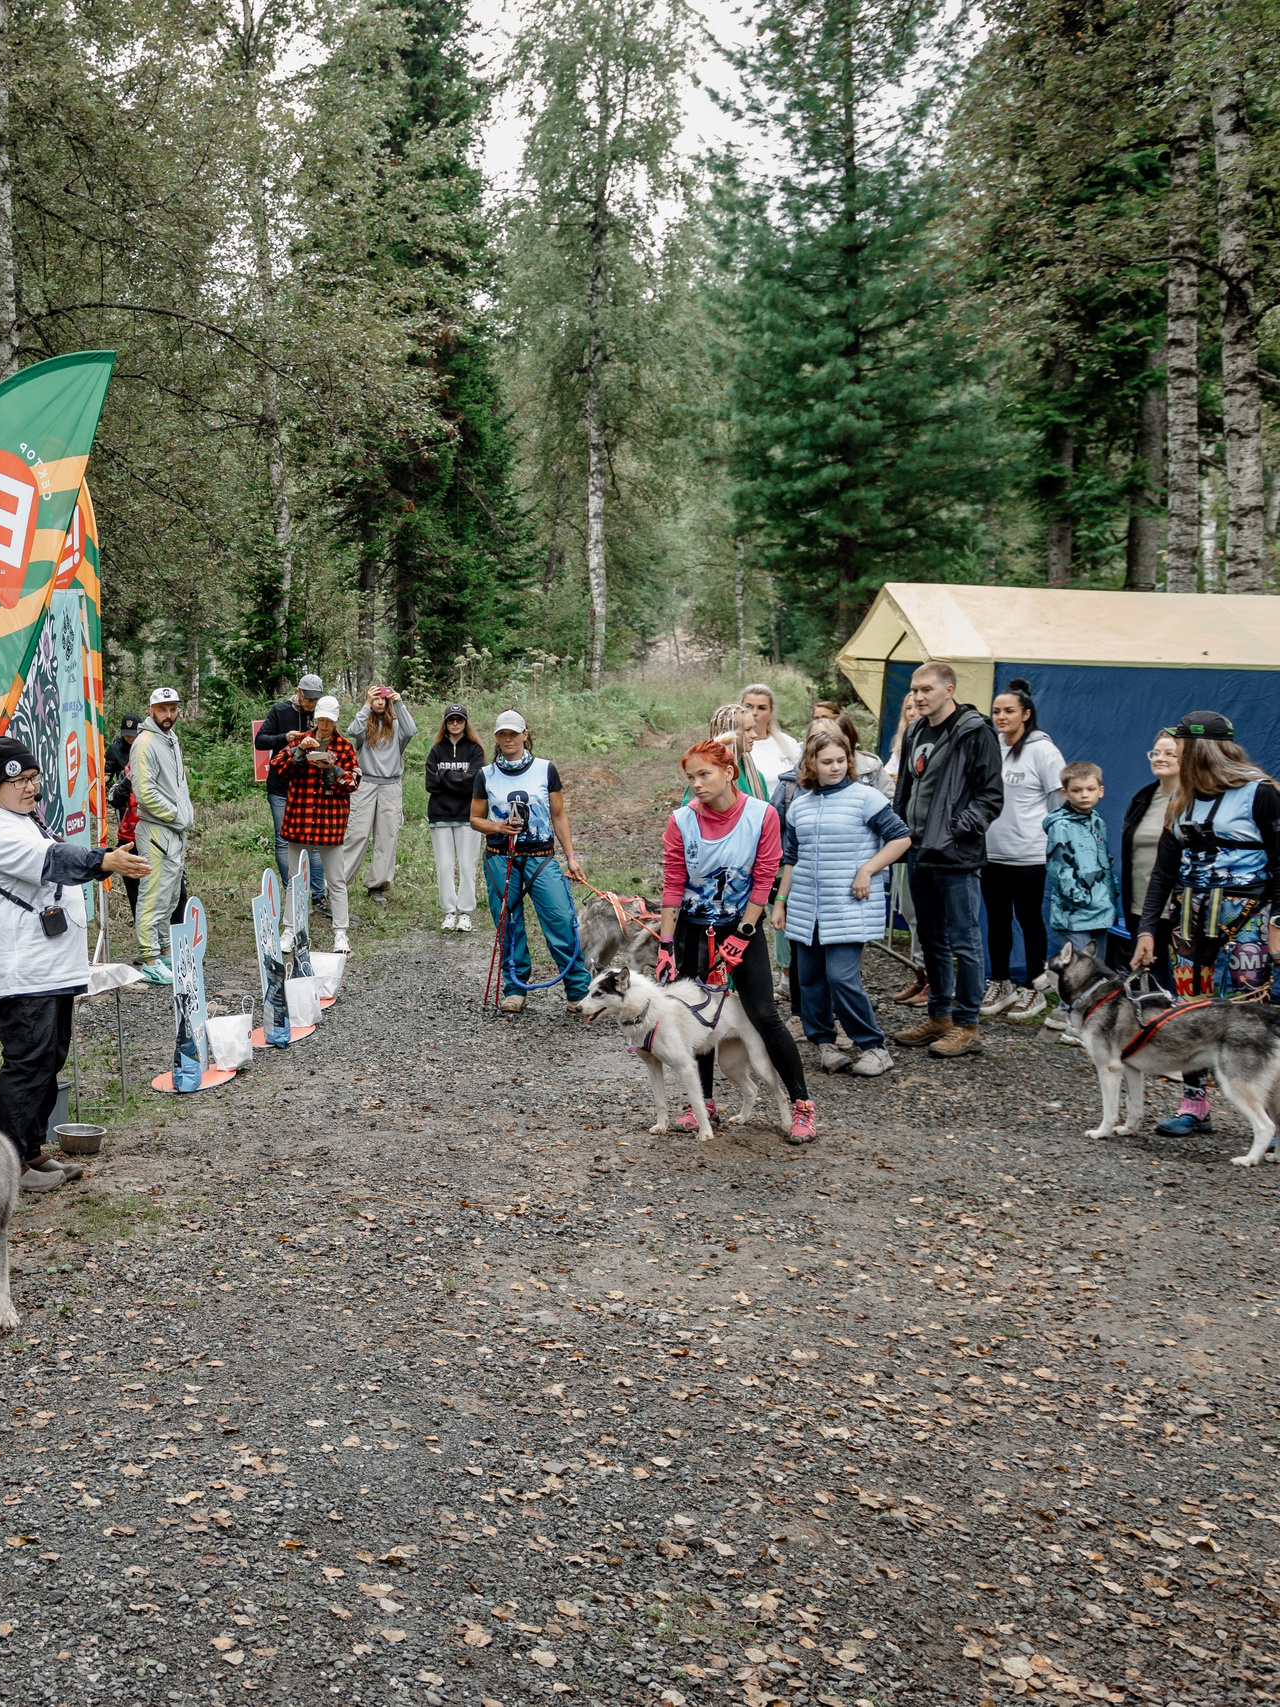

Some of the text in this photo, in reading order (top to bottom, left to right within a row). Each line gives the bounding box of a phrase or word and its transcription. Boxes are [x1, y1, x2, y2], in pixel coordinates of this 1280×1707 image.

[268, 875, 277, 918] 1
[712, 870, 727, 901] 1
[191, 905, 203, 949] 2
[723, 942, 742, 957] FLY
